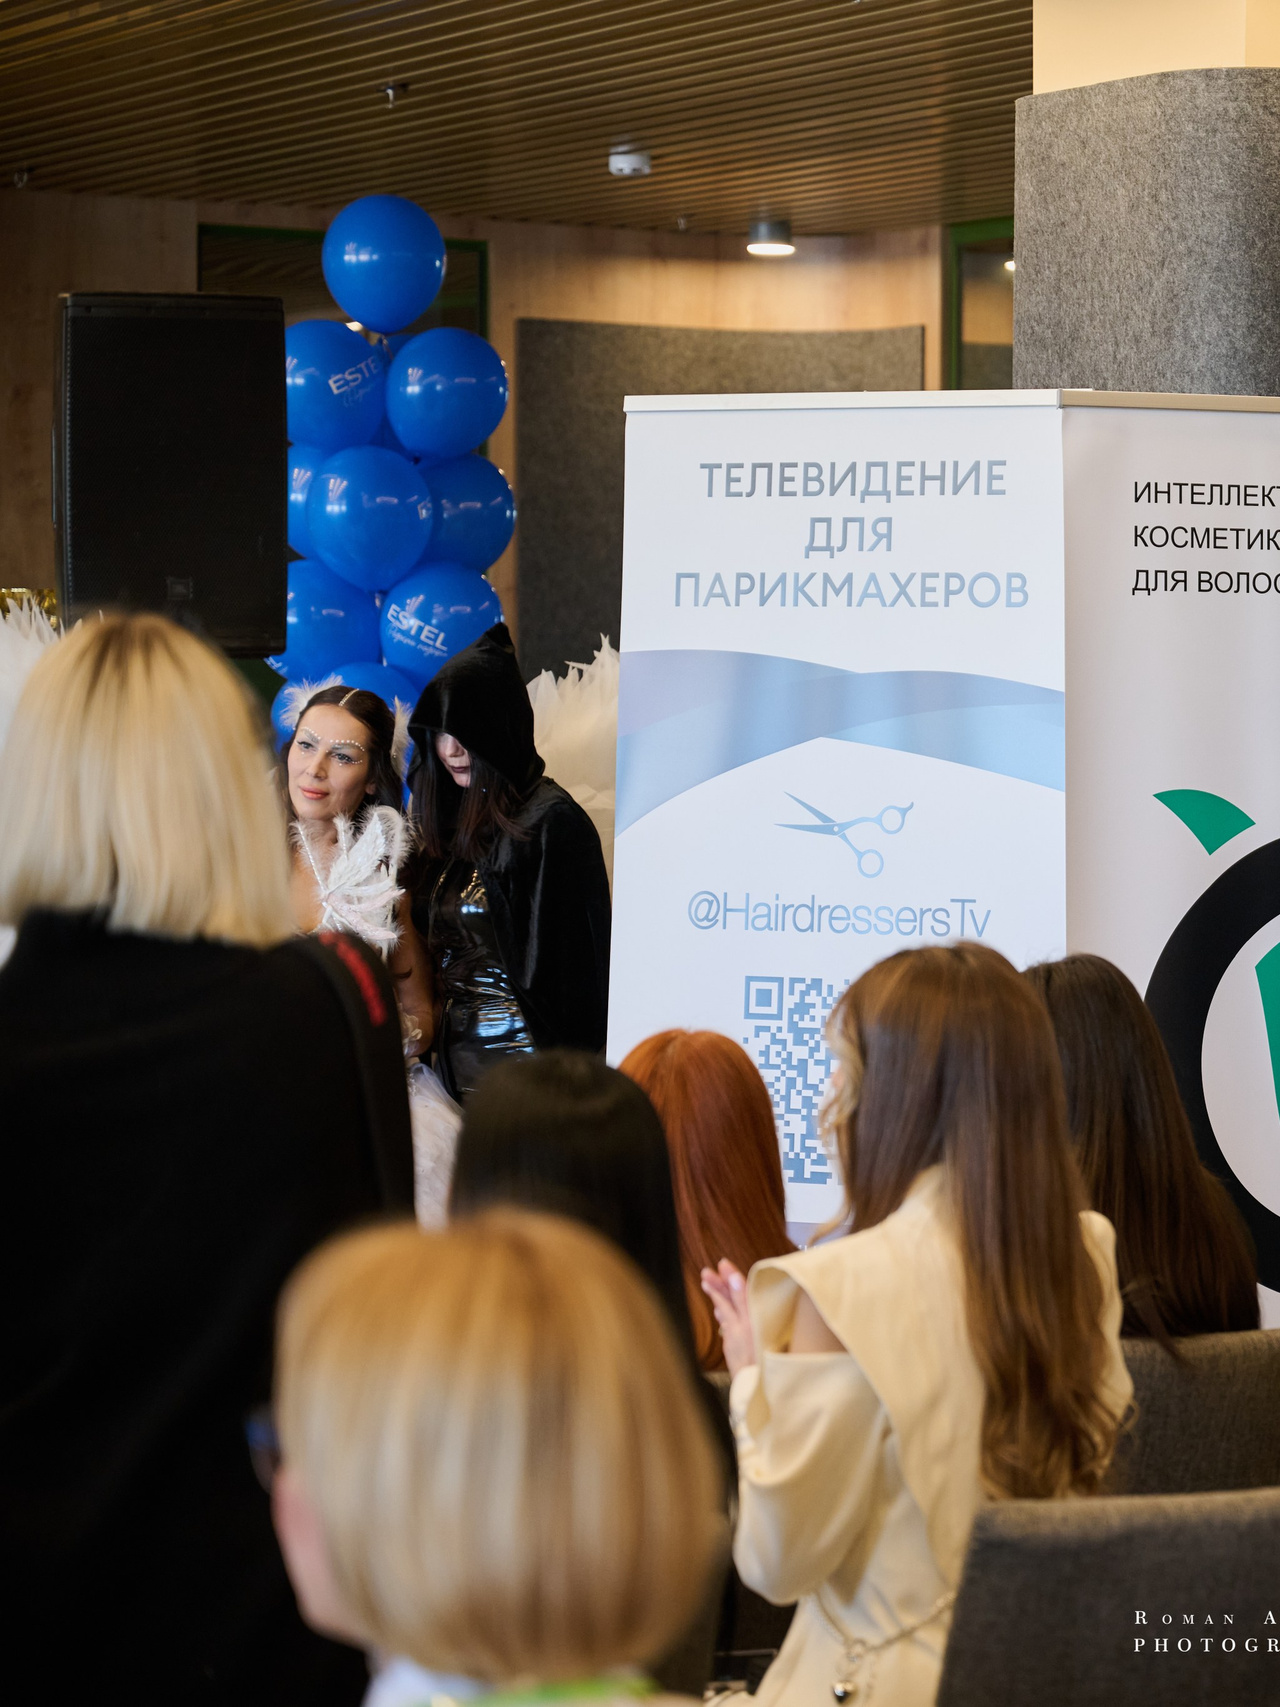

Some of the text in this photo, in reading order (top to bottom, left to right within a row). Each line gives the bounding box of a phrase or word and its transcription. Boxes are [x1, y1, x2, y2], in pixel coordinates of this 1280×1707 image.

[700, 460, 1007, 503] ТЕЛЕВИДЕНИЕ
[804, 516, 893, 559] ДЛЯ
[674, 572, 1029, 608] ПАРИКМАХЕРОВ
[1132, 569, 1188, 597] ДЛЯ
[387, 603, 448, 652] ESTEL
[687, 890, 992, 938] @HairdressersTv
